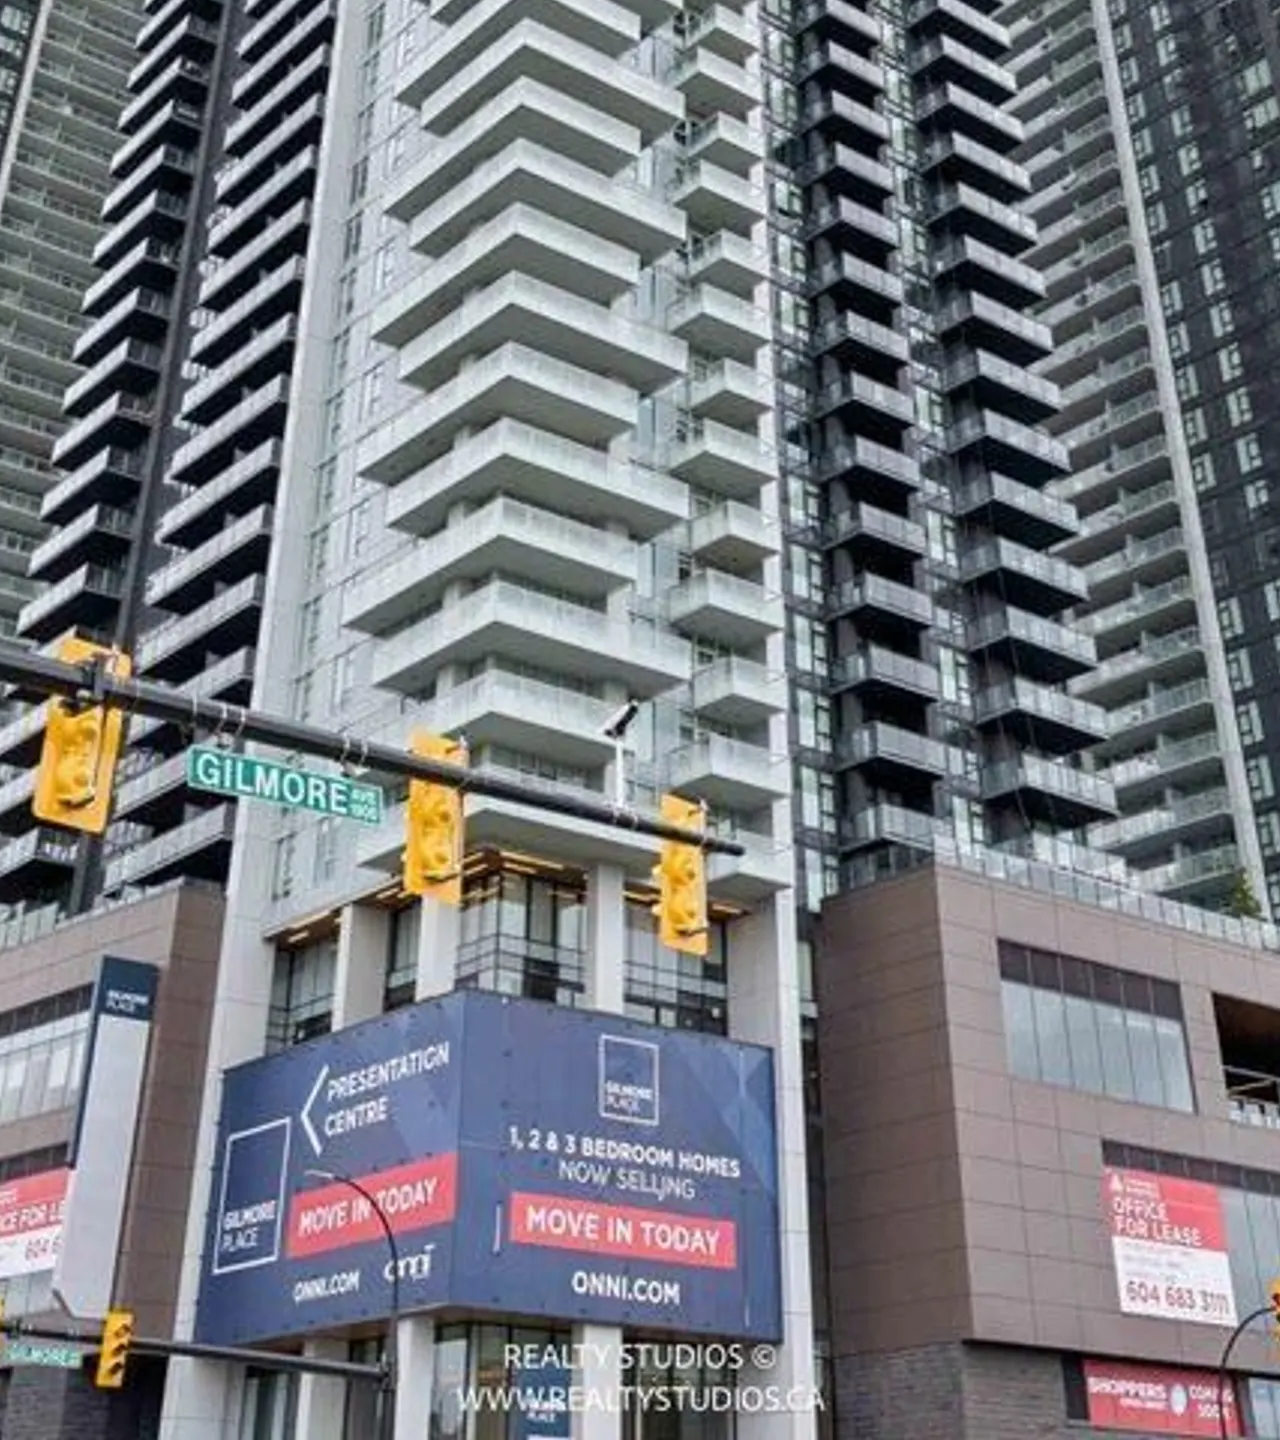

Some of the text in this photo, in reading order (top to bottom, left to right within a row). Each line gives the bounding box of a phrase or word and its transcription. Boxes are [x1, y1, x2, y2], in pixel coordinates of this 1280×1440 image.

[197, 753, 348, 814] GILMORE
[327, 1041, 450, 1102] PRESENTATION
[324, 1097, 389, 1137] CENTRE
[509, 1124, 741, 1178] 1, 2 & 3 BEDROOM HOMES
[558, 1160, 696, 1200] NOW SELLING
[223, 1200, 278, 1230] GILMORE
[298, 1176, 438, 1237] MOVE IN TODAY
[1113, 1197, 1168, 1222] OFFICE
[221, 1227, 259, 1252] PLACE
[526, 1205, 721, 1255] MOVE IN TODAY
[1114, 1215, 1202, 1246] FOR LEASE
[292, 1269, 362, 1304] ONNI.COM
[571, 1270, 681, 1305] ONNI.COM
[1126, 1280, 1160, 1304] 604
[1166, 1286, 1196, 1310] 683
[1087, 1376, 1167, 1399] SHOPPERS
